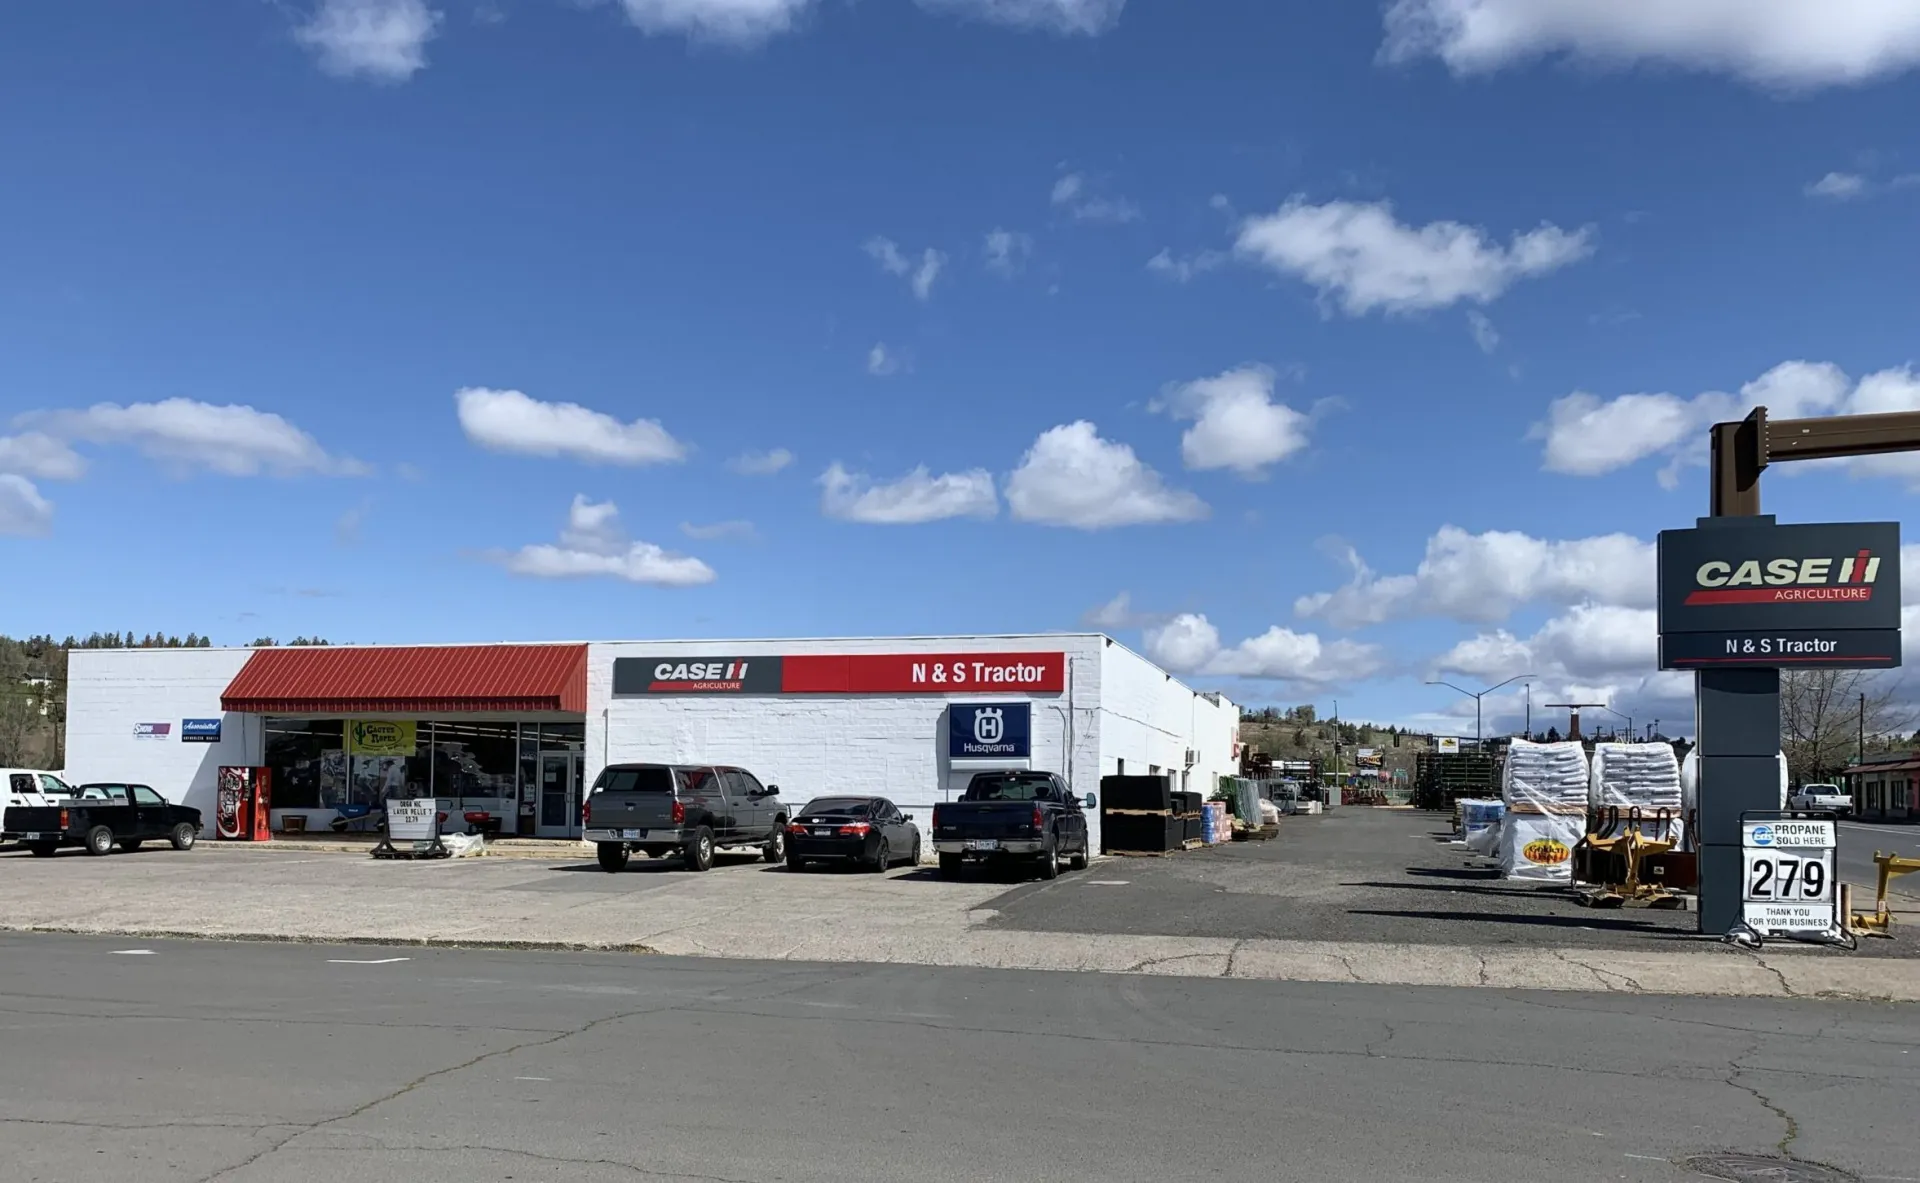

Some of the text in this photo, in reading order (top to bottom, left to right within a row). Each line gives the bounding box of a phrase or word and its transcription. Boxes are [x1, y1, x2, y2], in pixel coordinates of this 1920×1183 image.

[1696, 558, 1833, 588] CASE
[1774, 588, 1867, 600] AGRICULTURE
[1726, 637, 1838, 653] N & S Tractor
[654, 662, 724, 680] CASE
[912, 661, 1046, 683] N & S Tractor
[692, 682, 740, 690] AGRICULTURE
[963, 742, 1015, 754] Husqvarna
[1775, 824, 1827, 835] PROPANE
[1776, 836, 1827, 845] SOLD HERE
[1751, 859, 1824, 897] 279
[1766, 907, 1810, 917] THANK YOU
[1748, 917, 1828, 927] FOR YOUR BUSINESS
